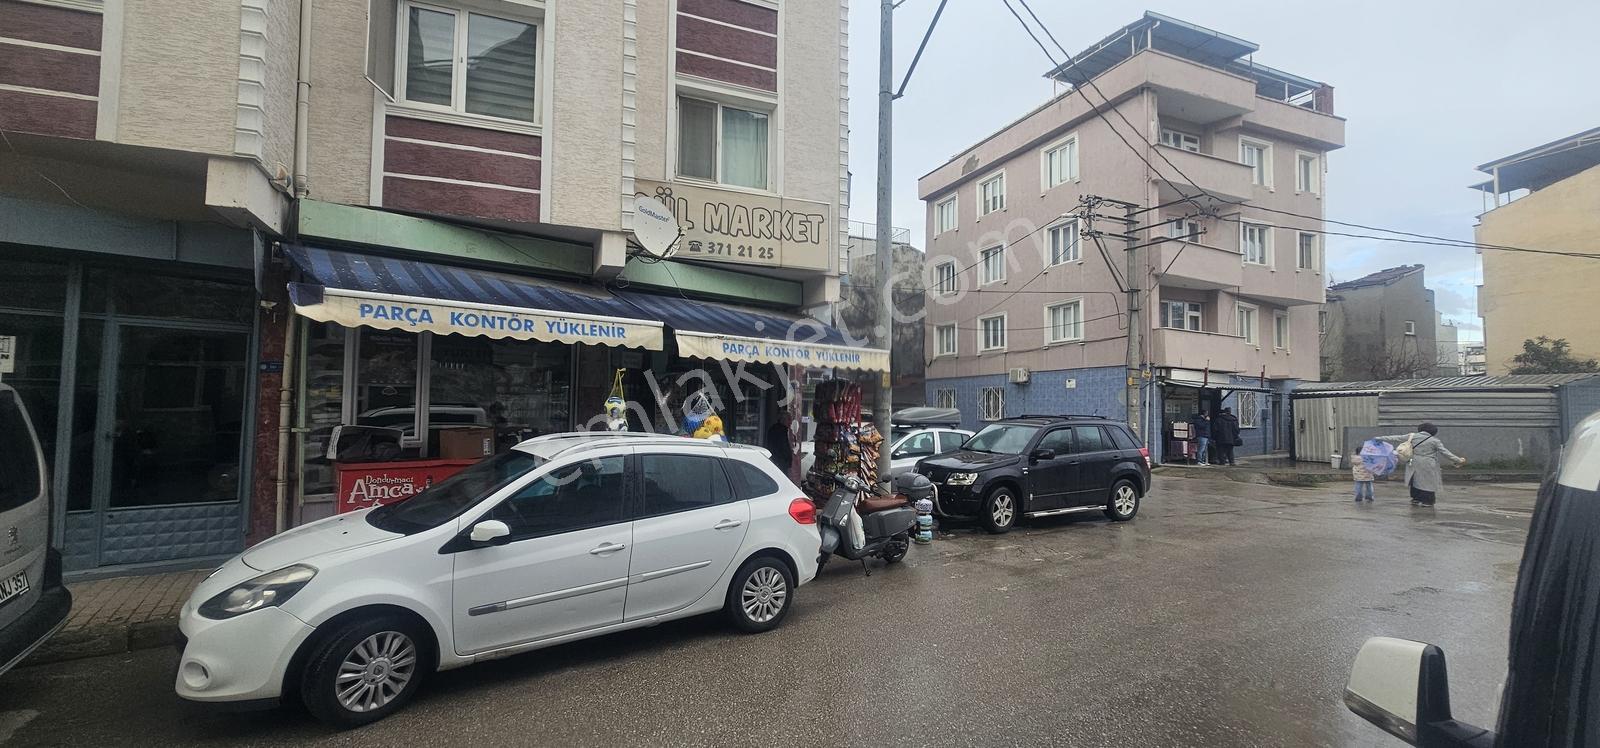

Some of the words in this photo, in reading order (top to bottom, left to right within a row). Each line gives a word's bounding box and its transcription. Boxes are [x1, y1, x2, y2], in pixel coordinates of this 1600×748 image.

[634, 186, 694, 231] ÜL
[704, 203, 824, 244] MARKET
[708, 241, 731, 256] 371
[737, 245, 753, 258] 21
[758, 247, 774, 260] 25
[359, 303, 433, 326] PARÇA
[450, 312, 534, 332] KONTÖR
[545, 317, 626, 339] YÜKLENİR
[722, 342, 760, 358] PARÇA
[347, 478, 414, 504] Amca
[12, 571, 26, 591] 357
